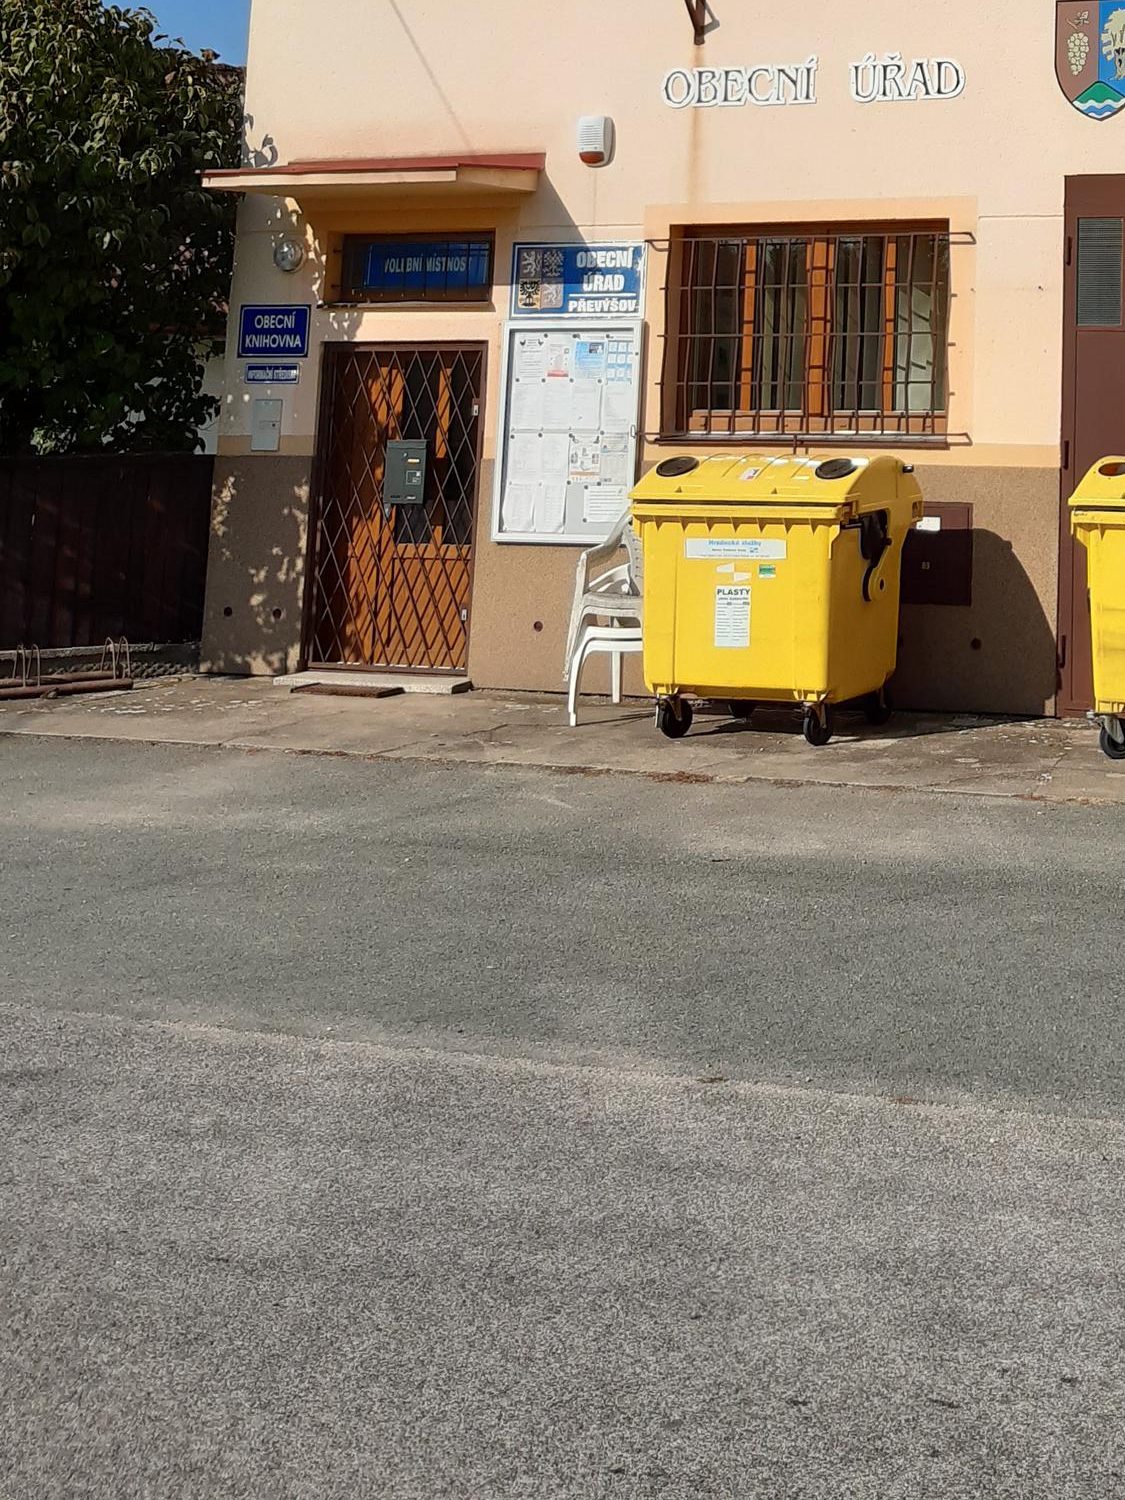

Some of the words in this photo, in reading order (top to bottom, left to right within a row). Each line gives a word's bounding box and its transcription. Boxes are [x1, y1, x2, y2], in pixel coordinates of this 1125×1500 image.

[663, 56, 818, 106] OBECNÍ
[853, 53, 963, 101] ÚŘAD
[576, 247, 634, 269] OBECNÍ
[582, 271, 625, 292] ÚŘAD
[568, 297, 637, 313] PŘEVÝŠOV
[254, 311, 296, 328] OBECNÍ
[245, 334, 302, 349] KNIHOVNA
[717, 588, 750, 596] PLASTY
